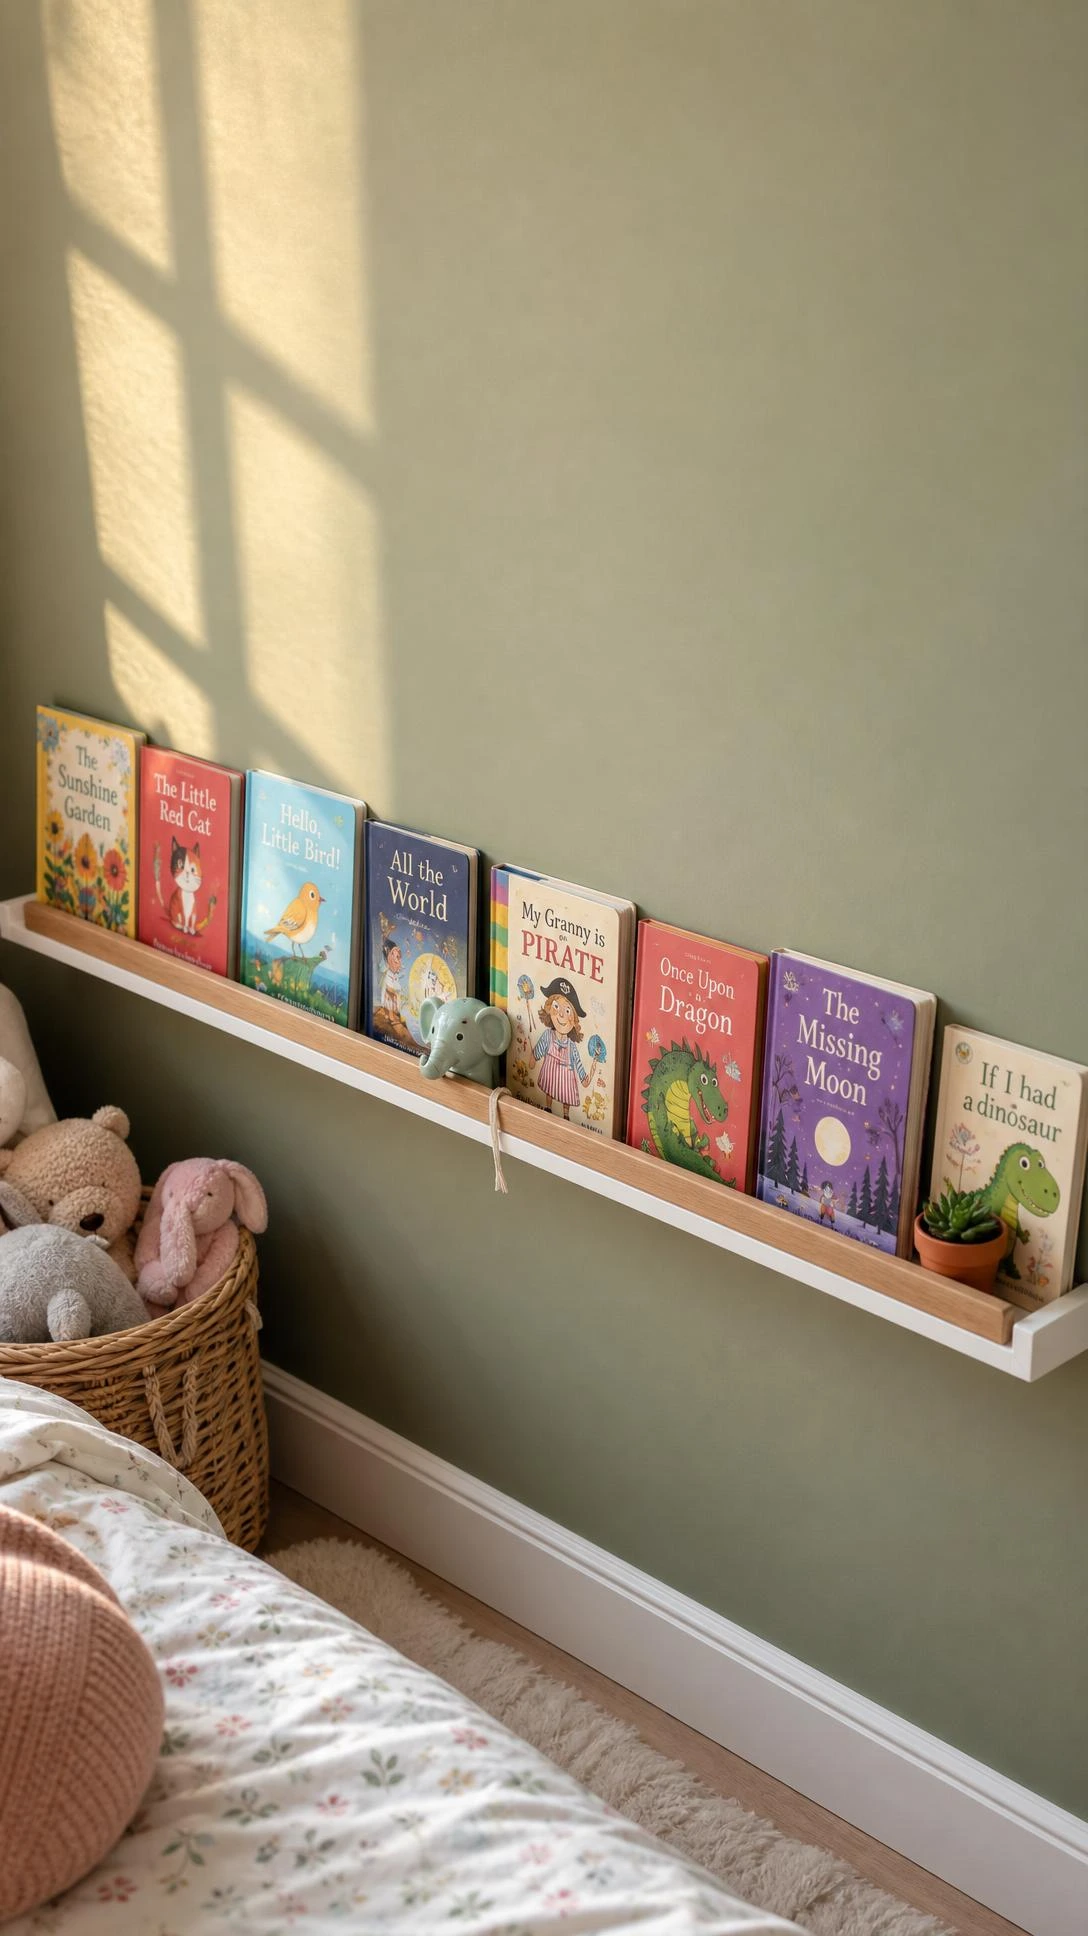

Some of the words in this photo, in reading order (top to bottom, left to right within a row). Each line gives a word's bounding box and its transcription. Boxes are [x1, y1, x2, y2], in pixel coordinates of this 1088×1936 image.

[76, 745, 98, 770] The
[58, 768, 118, 806] Sunshine
[154, 773, 177, 797] The
[181, 782, 216, 812] Little
[64, 795, 111, 832] Garden
[160, 800, 184, 827] Red
[188, 811, 212, 836] Cat
[280, 804, 321, 839] Hello,
[261, 823, 300, 855] Little
[305, 838, 341, 870] Bird!
[390, 850, 412, 876] All
[418, 860, 443, 887] the
[387, 877, 448, 922] World
[522, 901, 541, 926] My
[545, 908, 591, 947] Granny
[596, 929, 605, 947] is
[521, 930, 604, 984] PIRATE
[660, 957, 694, 984] Once
[699, 971, 735, 1000] Upon
[659, 986, 733, 1036] Dragon
[823, 988, 860, 1025] The
[797, 1015, 882, 1081] Missing
[804, 1056, 867, 1106] Moon
[980, 1062, 998, 1087] If
[1005, 1070, 1013, 1094] I
[1020, 1077, 1057, 1111] had
[963, 1096, 972, 1111] a
